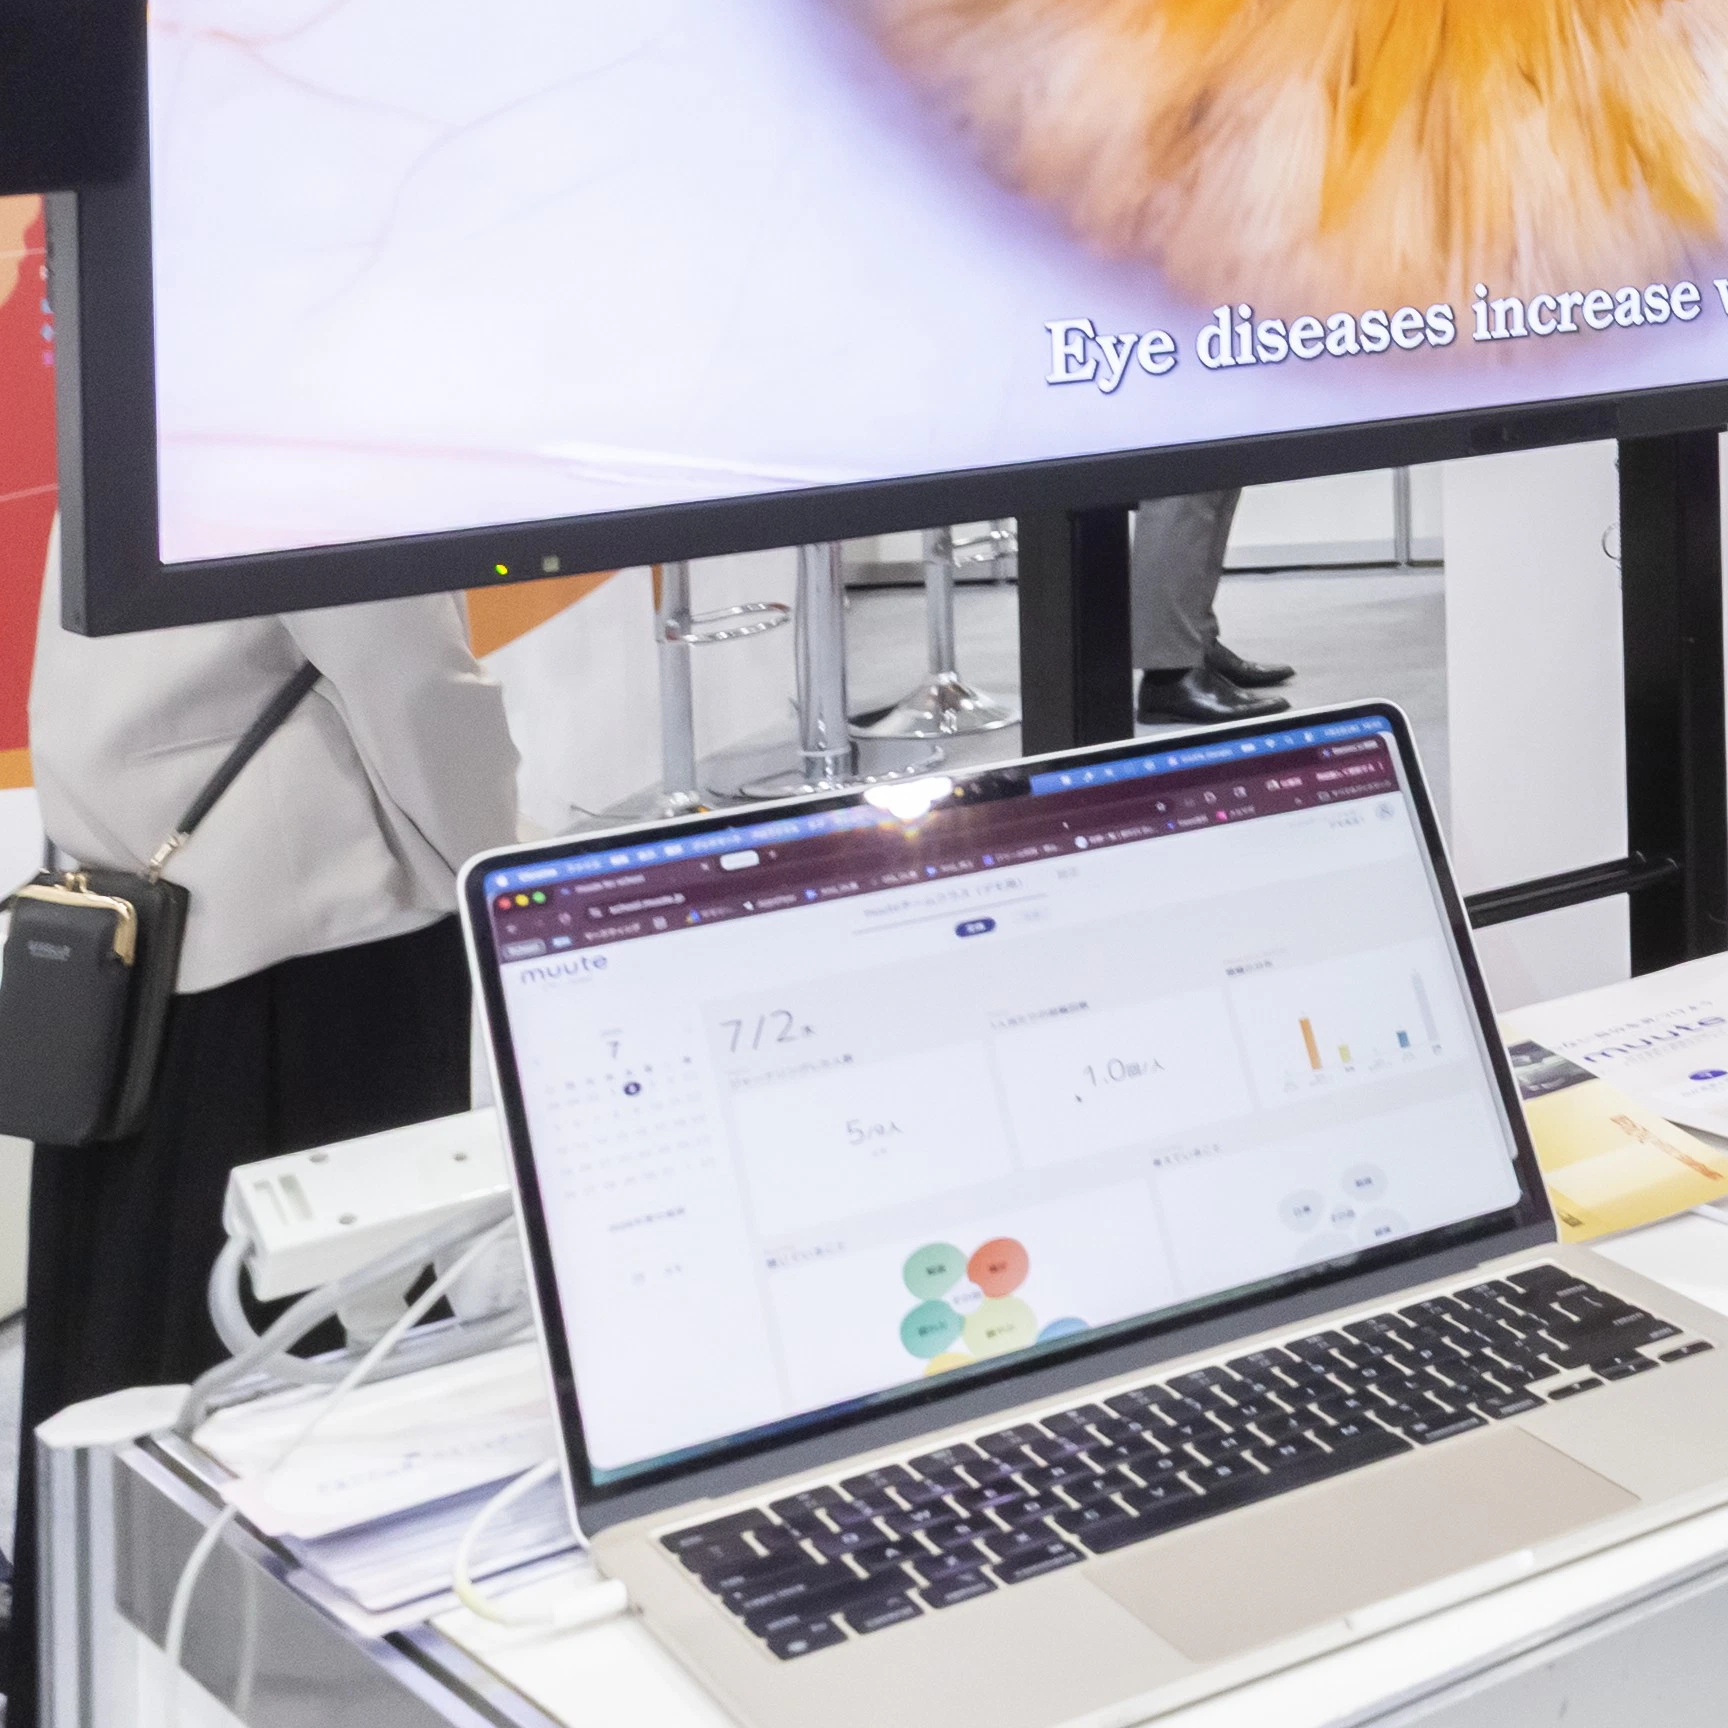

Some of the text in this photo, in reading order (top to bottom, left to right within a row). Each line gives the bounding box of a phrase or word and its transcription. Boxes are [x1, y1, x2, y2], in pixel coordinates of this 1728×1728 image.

[1043, 317, 1178, 394] Eye
[1197, 303, 1456, 370] diseases
[1472, 283, 1703, 344] increase
[520, 954, 608, 984] muute
